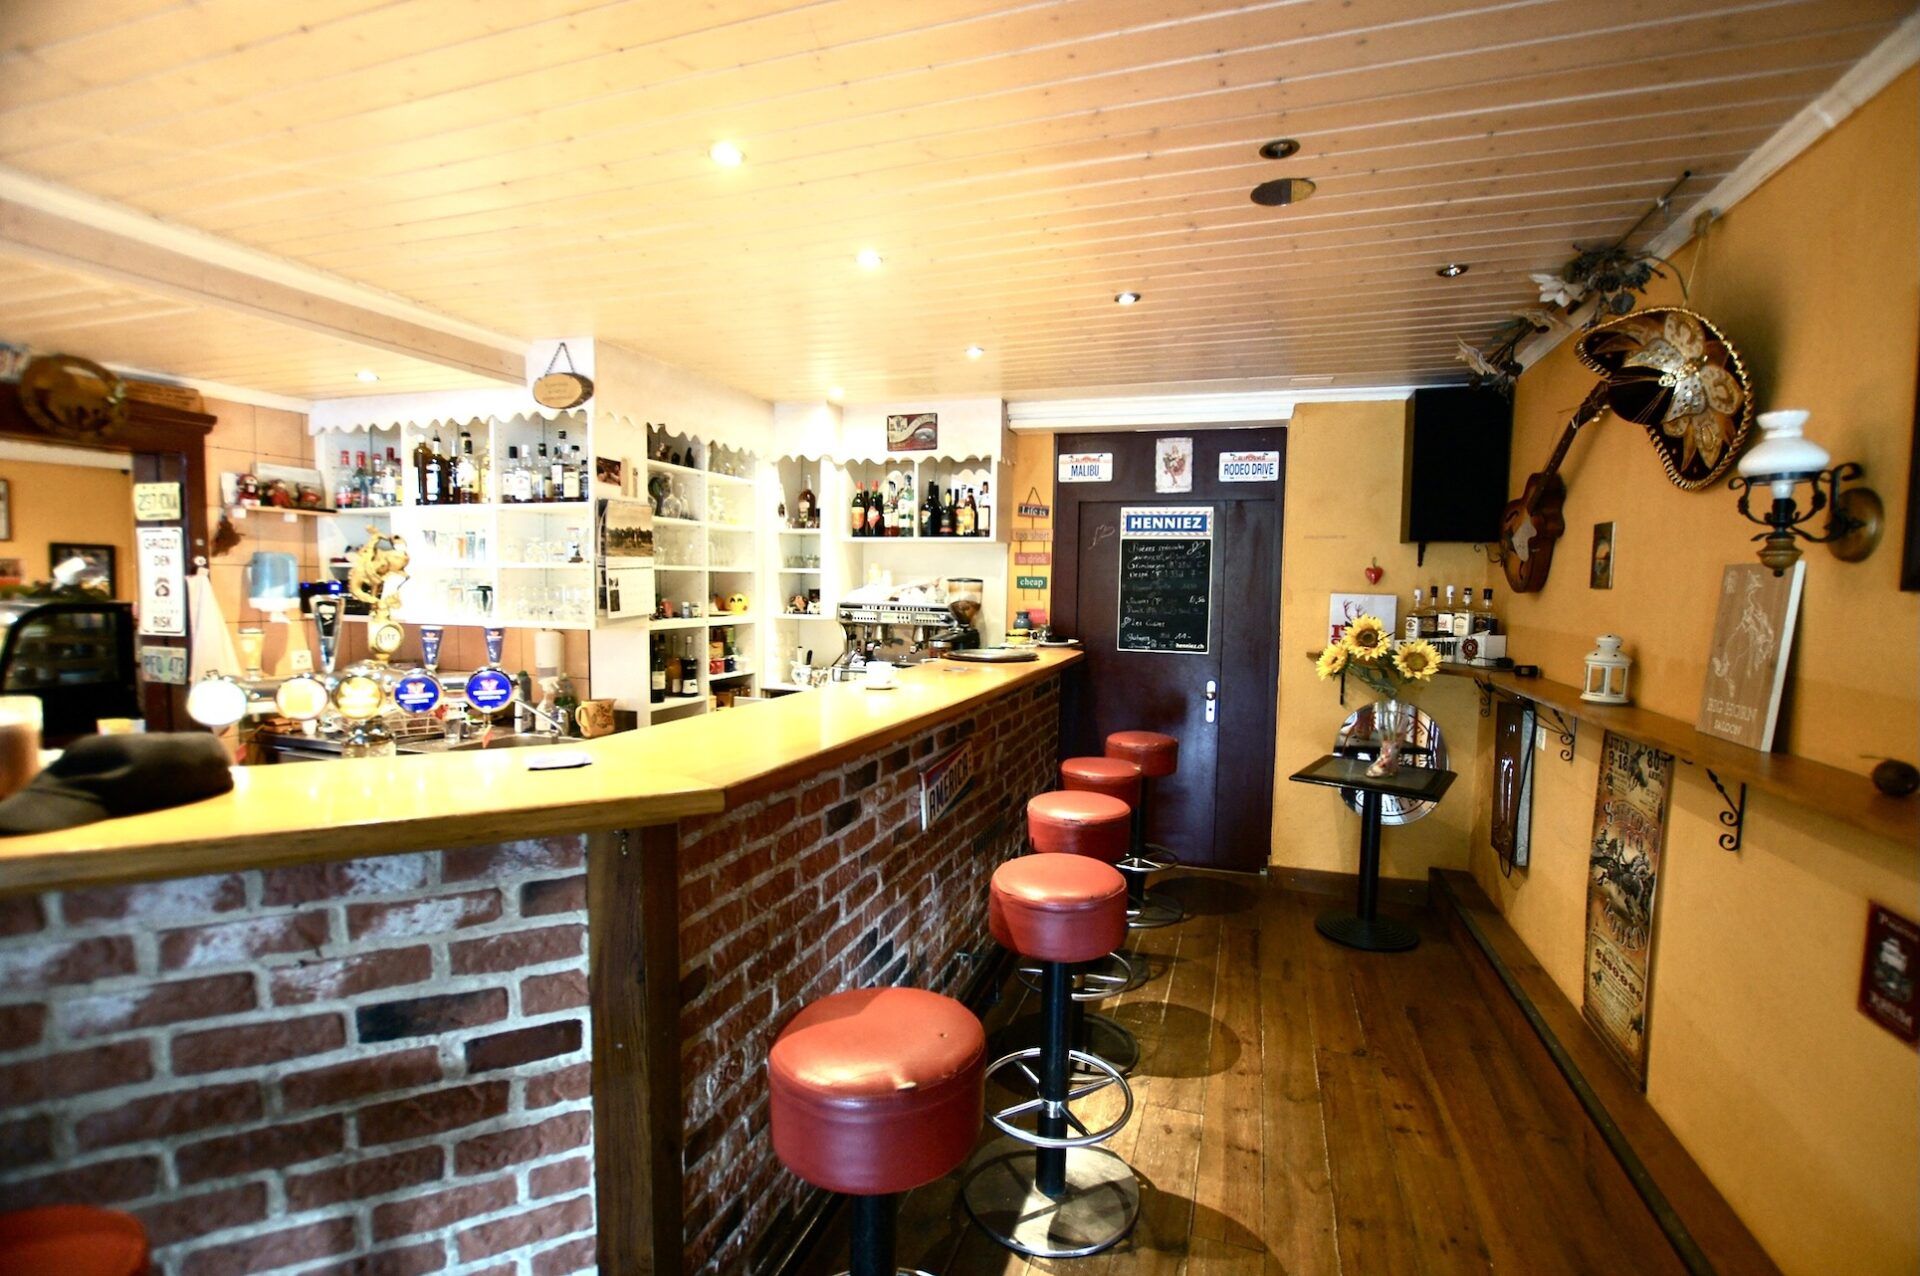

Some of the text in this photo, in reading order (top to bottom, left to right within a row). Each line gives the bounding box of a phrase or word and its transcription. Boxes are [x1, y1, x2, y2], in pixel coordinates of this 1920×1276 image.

[1070, 464, 1100, 477] MALIBU
[1223, 462, 1274, 476] RODEO DRIVE
[1021, 505, 1047, 516] Life is
[1130, 517, 1202, 530] HENNIEZ
[153, 555, 171, 567] DEN
[1019, 578, 1044, 588] cheap
[152, 615, 172, 628] RISK
[1706, 697, 1758, 721] BIG HORN
[1713, 719, 1743, 736] SALOON
[929, 751, 969, 821] AMERICA
